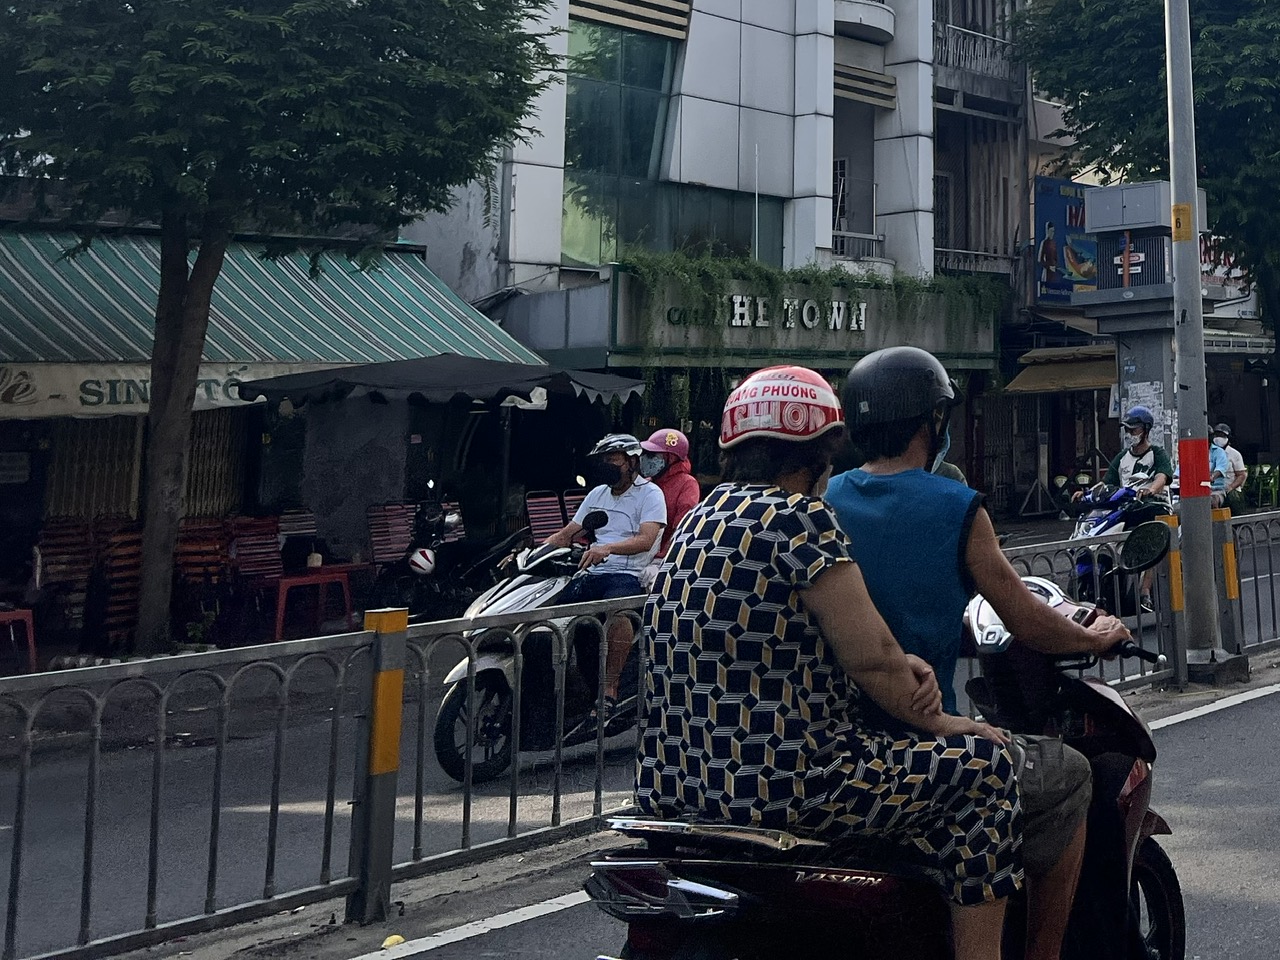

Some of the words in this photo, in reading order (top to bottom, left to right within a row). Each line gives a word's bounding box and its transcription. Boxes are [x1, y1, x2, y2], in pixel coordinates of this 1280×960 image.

[1175, 217, 1182, 229] 6
[783, 297, 868, 331] TOWN
[762, 384, 817, 400] PHƯƠNG
[795, 871, 883, 887] VISION
